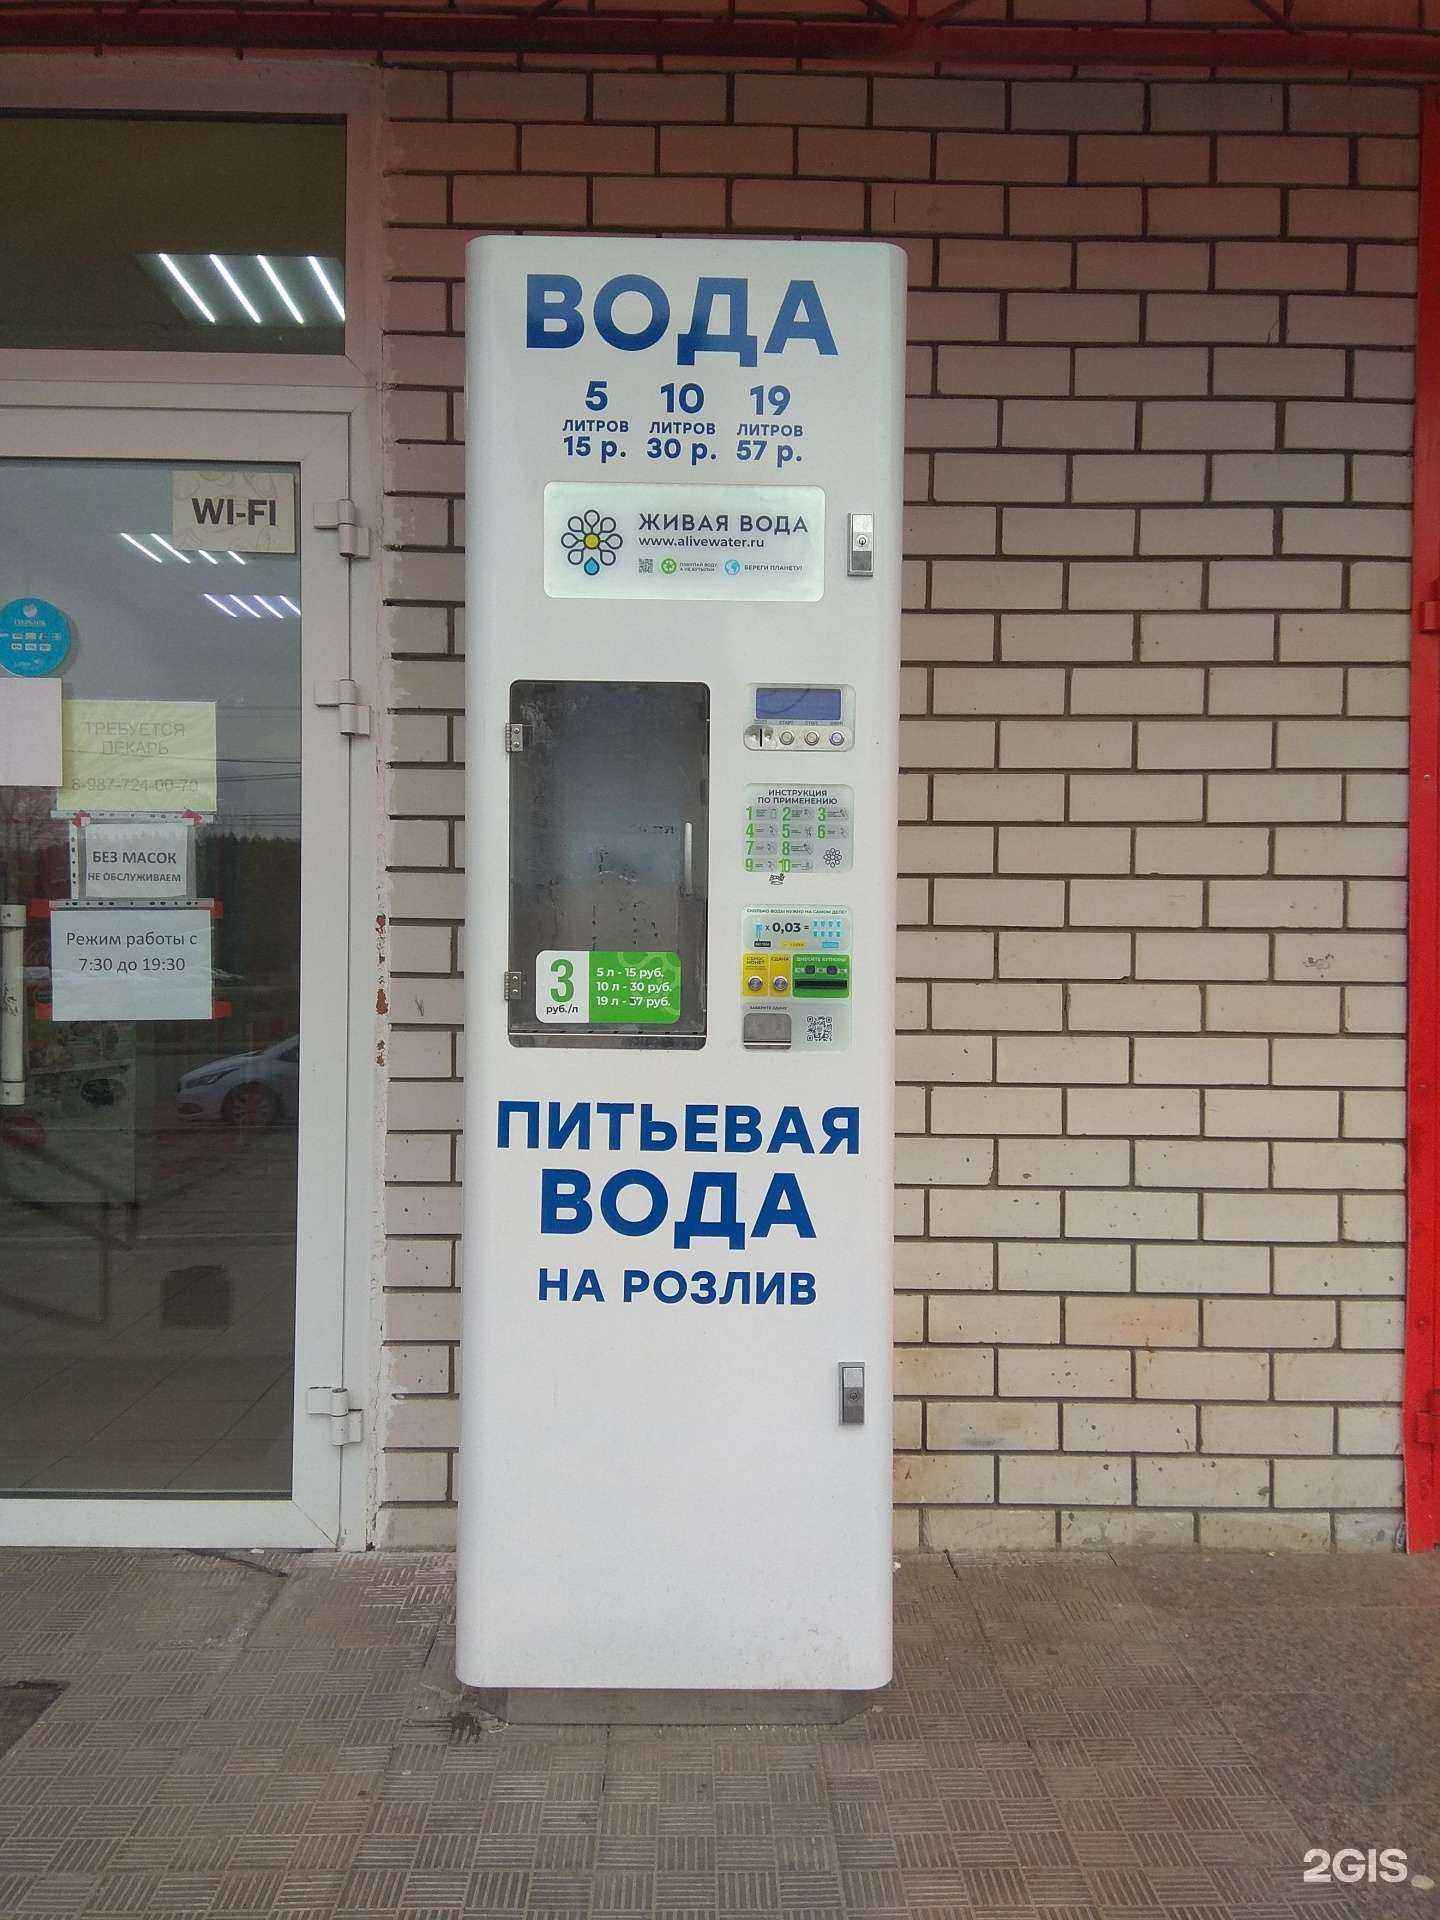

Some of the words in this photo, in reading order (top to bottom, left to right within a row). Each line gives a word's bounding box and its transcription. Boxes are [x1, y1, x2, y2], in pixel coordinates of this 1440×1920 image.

[526, 273, 839, 367] ВОДА
[585, 381, 608, 411] 5
[660, 383, 705, 413] 10
[750, 385, 791, 415] 19
[562, 420, 629, 432] ЛИТРОВ
[649, 422, 716, 435] ЛИТРОВ
[736, 424, 803, 437] ЛИТРОВ
[563, 436, 591, 456] 15
[601, 440, 626, 463] р.
[647, 438, 681, 458] 30
[691, 443, 717, 465] р.
[736, 440, 767, 460] 57
[777, 445, 802, 467] р.
[191, 498, 277, 526] WI-FI
[639, 513, 729, 532] ЖИВАЯ
[740, 515, 808, 535] ВОДА
[639, 536, 764, 547] www.alivewater.ru
[86, 721, 185, 737] ТРЕБУЕТСЯ
[768, 789, 828, 797] ИНСТРУКЦИЯ
[746, 806, 752, 820] 1
[782, 807, 791, 820] 2
[817, 807, 826, 821] 3
[746, 823, 754, 838] 4
[782, 824, 790, 838] 5
[817, 825, 826, 838] 6
[746, 840, 754, 855] 7
[782, 841, 790, 855] 8
[92, 851, 118, 863] БЕЗ
[122, 852, 177, 864] МАСОК
[745, 858, 754, 872] 9
[779, 858, 791, 872] 10
[88, 872, 101, 880] НЕ
[103, 872, 181, 882] ОБСЛУЖИВАЕМ
[772, 922, 801, 934] 0,03
[67, 932, 122, 945] Режим
[126, 931, 184, 948] работы
[190, 935, 197, 945] с
[79, 958, 113, 971] 7:30
[117, 961, 137, 973] до
[143, 958, 185, 971] 19:30
[596, 968, 604, 977] 5
[607, 969, 615, 977] л
[625, 968, 637, 977] 15
[640, 968, 664, 979] руб.
[550, 959, 575, 1003] 3
[597, 982, 609, 991] 10
[612, 983, 620, 991] л
[630, 982, 644, 991] 30
[648, 982, 672, 993] руб.
[597, 996, 608, 1006] 19
[611, 998, 619, 1006] л
[647, 997, 671, 1008] руб.
[546, 1006, 578, 1015] руб./л
[497, 1101, 860, 1154] ПИТЬЕВАЯ
[540, 1168, 817, 1250] ВОДА
[538, 1268, 605, 1302] НА
[623, 1270, 817, 1305] РОЗЛИВ
